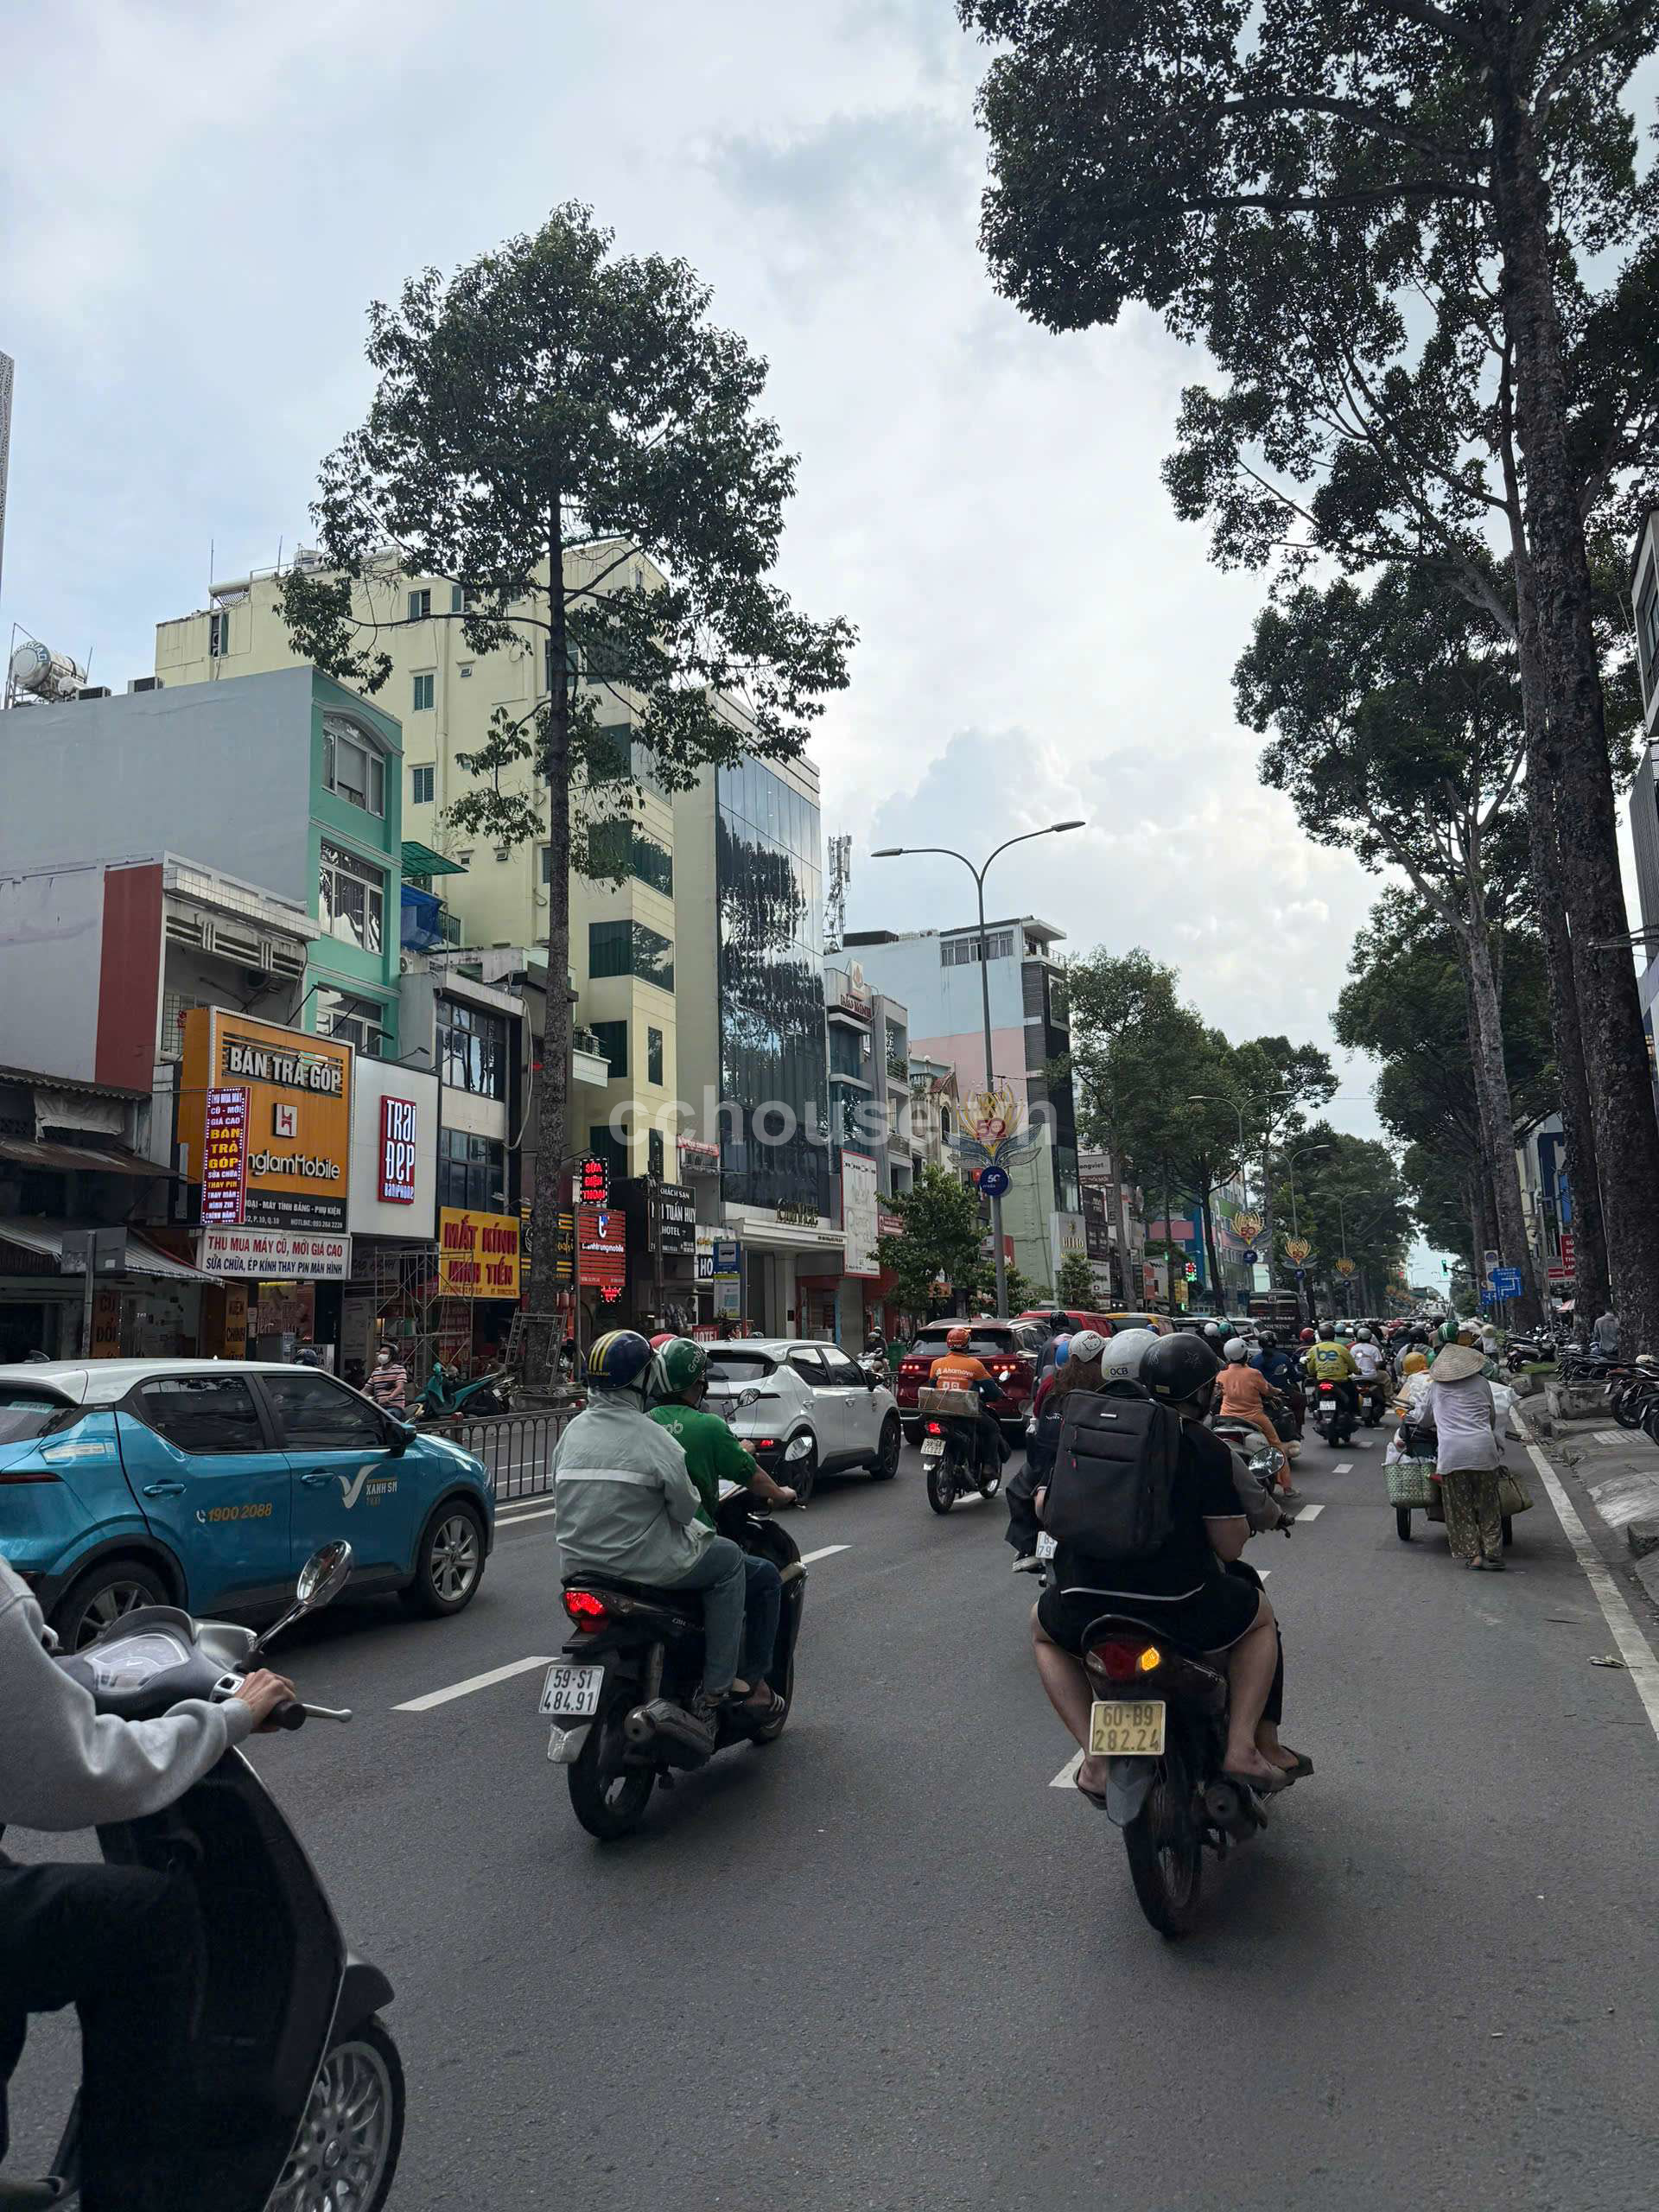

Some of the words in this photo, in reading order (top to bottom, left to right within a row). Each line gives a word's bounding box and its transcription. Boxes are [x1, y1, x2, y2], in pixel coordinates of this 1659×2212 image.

[230, 1046, 268, 1078] BÁN
[272, 1051, 307, 1086] TRẢ
[309, 1063, 342, 1093] GÓP
[210, 1116, 224, 1126] GIÁ
[225, 1116, 240, 1125] CAO
[210, 1127, 241, 1139] BÁN
[210, 1141, 238, 1154] TRẢ
[208, 1156, 238, 1169] GÓP
[585, 1160, 602, 1174] SỬA
[1078, 1161, 1104, 1170] ongviet
[584, 1175, 603, 1188] ĐIỆN
[262, 1199, 276, 1211] MÁY
[665, 1200, 683, 1222] TUẤN
[683, 1206, 696, 1224] HUY
[661, 1225, 681, 1236] HOTEL
[481, 1221, 518, 1255] KÍNH
[207, 1236, 228, 1250] THU
[230, 1236, 250, 1252] MUA
[252, 1236, 274, 1254] MÁY
[276, 1237, 289, 1256] CŨ,
[292, 1238, 309, 1255] MỚI
[311, 1238, 325, 1256] GIÁ
[326, 1244, 343, 1257] CAO
[206, 1253, 222, 1270] SỬA
[223, 1255, 246, 1273] CHỮA,
[247, 1256, 258, 1271] ÉP
[259, 1257, 276, 1273] KÍNH
[278, 1261, 296, 1274] THAY
[297, 1262, 309, 1274] PIN
[310, 1260, 325, 1274] MÀN
[326, 1262, 343, 1275] HÌNH
[1315, 1347, 1339, 1362] be
[1109, 1367, 1129, 1376] OCB
[365, 1483, 387, 1496] XANH
[387, 1480, 398, 1493] SM
[207, 1506, 239, 1522] 1900
[240, 1503, 273, 1519] 2088
[543, 1690, 594, 1712] 484.91
[1094, 1728, 1160, 1751] 282.24
